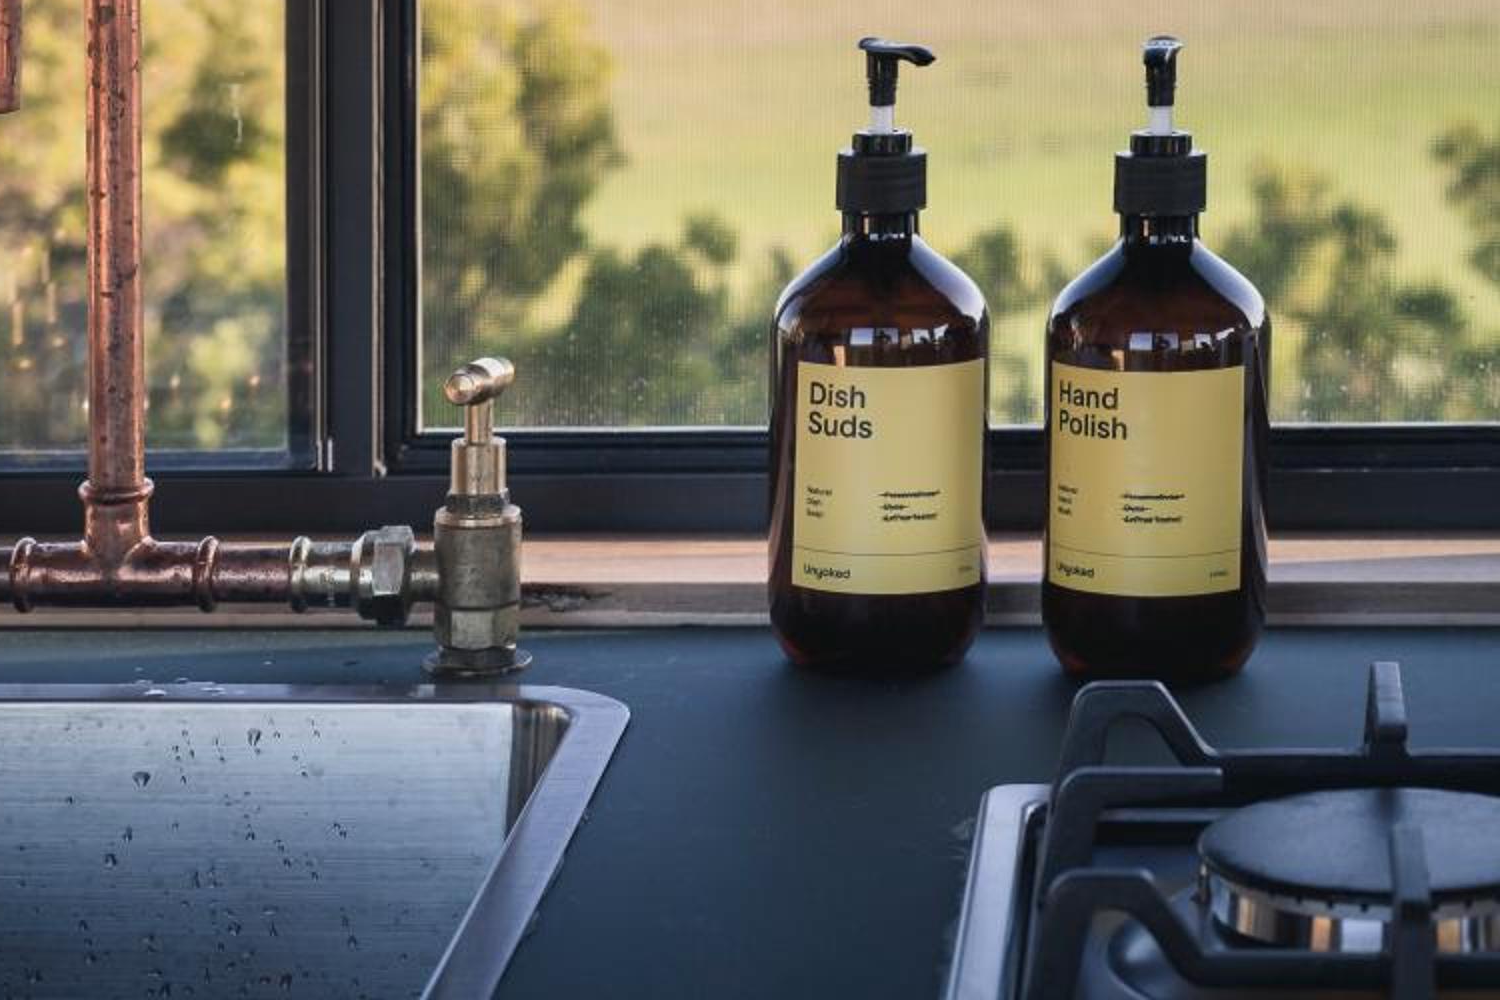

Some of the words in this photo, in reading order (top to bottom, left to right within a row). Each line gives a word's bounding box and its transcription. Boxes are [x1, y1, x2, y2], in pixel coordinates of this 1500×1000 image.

[809, 381, 866, 409] Dish
[1059, 379, 1119, 410] Hand
[808, 411, 873, 439] Suds
[1059, 409, 1128, 440] Polish
[803, 562, 851, 580] Unyoked
